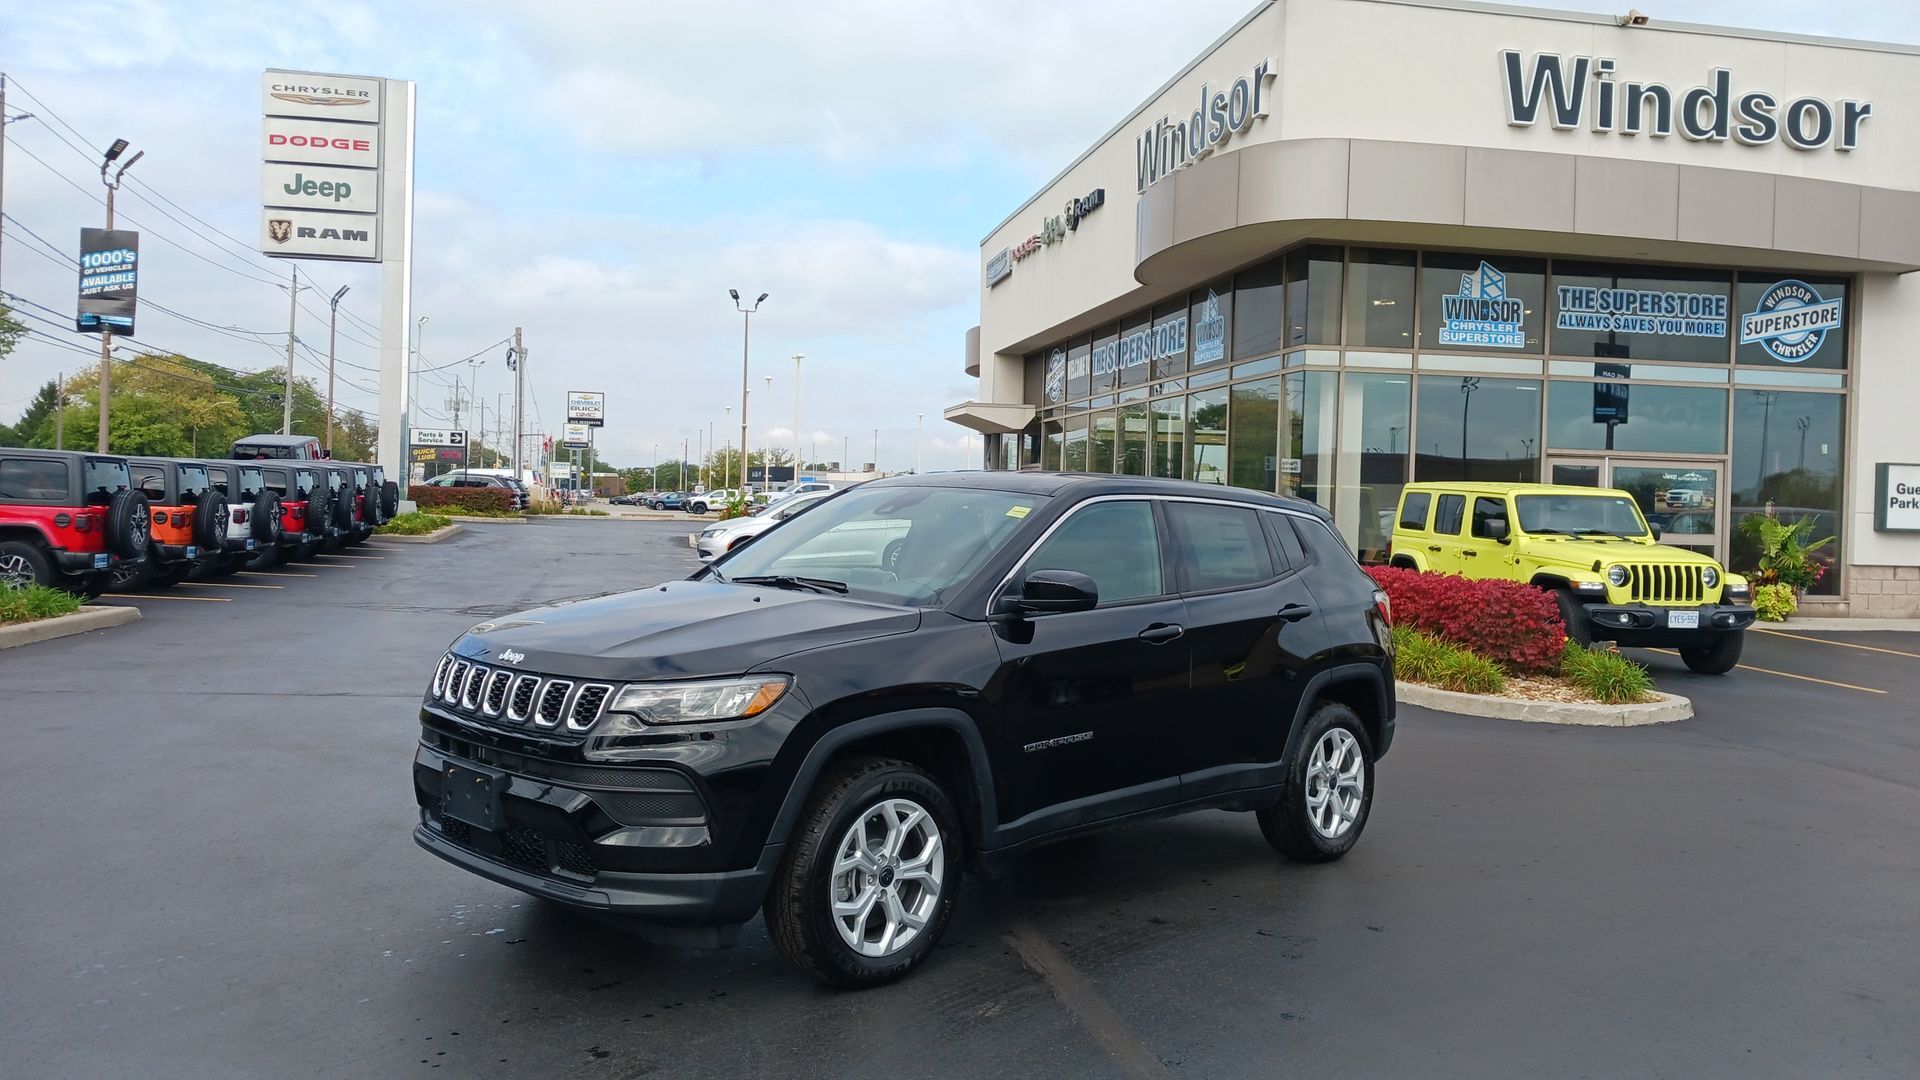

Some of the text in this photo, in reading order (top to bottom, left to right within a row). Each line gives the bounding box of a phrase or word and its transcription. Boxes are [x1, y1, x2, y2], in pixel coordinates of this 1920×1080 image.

[271, 84, 369, 97] CHRYSLER
[1500, 48, 1873, 152] Windsor
[1135, 56, 1278, 195] Windsor
[269, 134, 370, 151] DODGE
[284, 173, 351, 202] Jeep
[1074, 189, 1104, 218] RAM
[297, 226, 368, 242] RAM
[82, 250, 136, 268] 1000's
[84, 263, 133, 275] OF VEHICLES
[81, 286, 101, 295] JUST
[103, 284, 120, 292] ASK
[82, 273, 135, 288] AVAILABLE
[1558, 287, 1726, 317] THE SUPERSTORE
[1765, 286, 1812, 308] WINDSOR
[1445, 298, 1521, 323] WINDSOR
[1451, 321, 1513, 332] CHRYSLER
[1559, 312, 1725, 335] ALWAYS SAVES YOU MORE!
[1745, 306, 1838, 336] SUPERSTORE
[1443, 331, 1522, 344] SUPERSTORE
[1772, 333, 1819, 357] CHRYSLER
[1093, 347, 1105, 375] THE
[1107, 319, 1186, 372] SUPERSTORE
[412, 448, 436, 456] QUICK
[1662, 472, 1677, 480] Jeep
[1890, 497, 1920, 509] Park
[498, 648, 525, 664] Jeep
[1024, 731, 1094, 753] COMPASS
